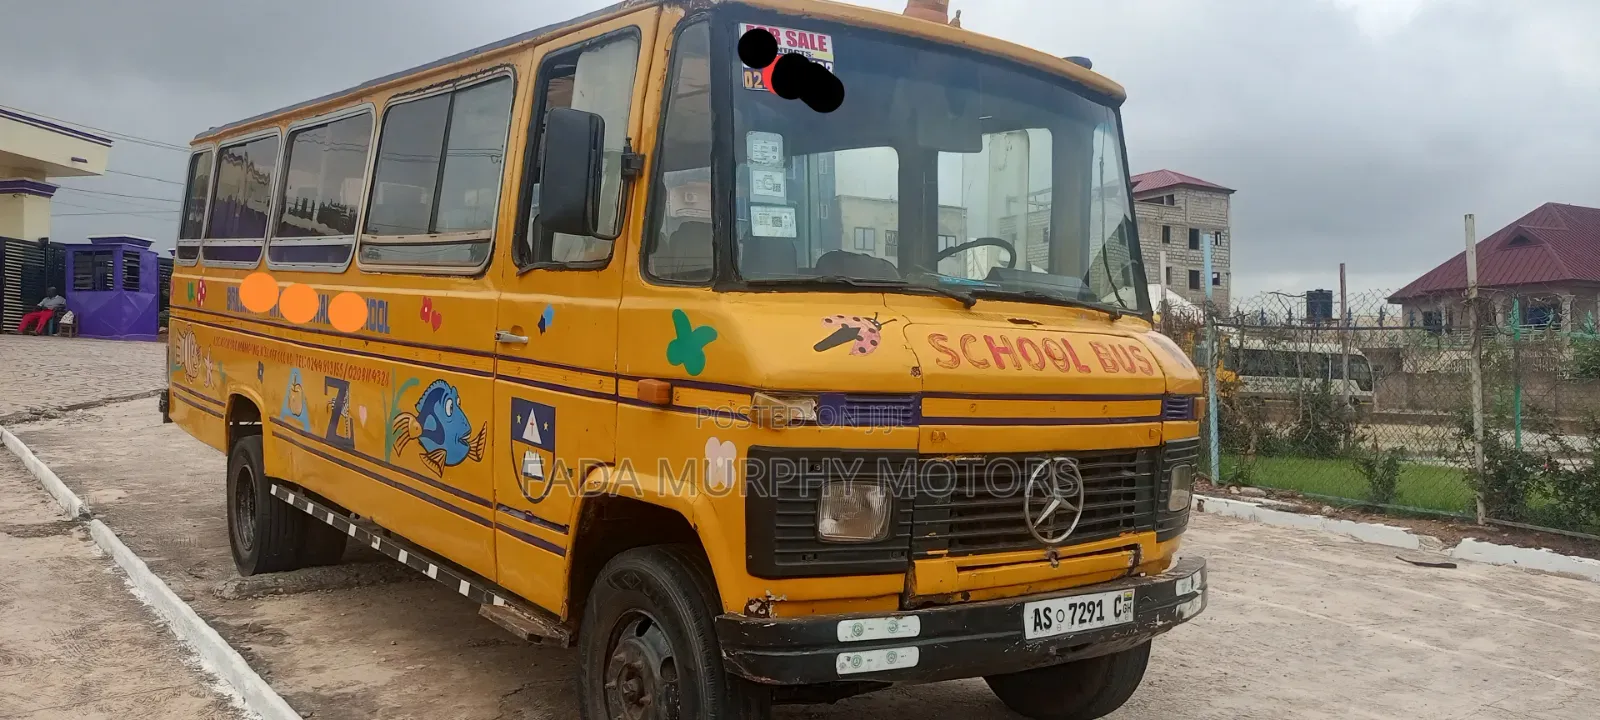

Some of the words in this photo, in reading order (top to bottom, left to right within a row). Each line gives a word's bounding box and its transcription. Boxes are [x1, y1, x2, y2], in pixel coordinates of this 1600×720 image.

[785, 30, 828, 52] SALE
[927, 332, 1092, 374] SCHOOL
[1089, 340, 1154, 376] BUS
[1033, 607, 1053, 632] AS
[1068, 600, 1105, 626] 7291
[1114, 595, 1122, 618] C
[1122, 601, 1132, 614] GH
